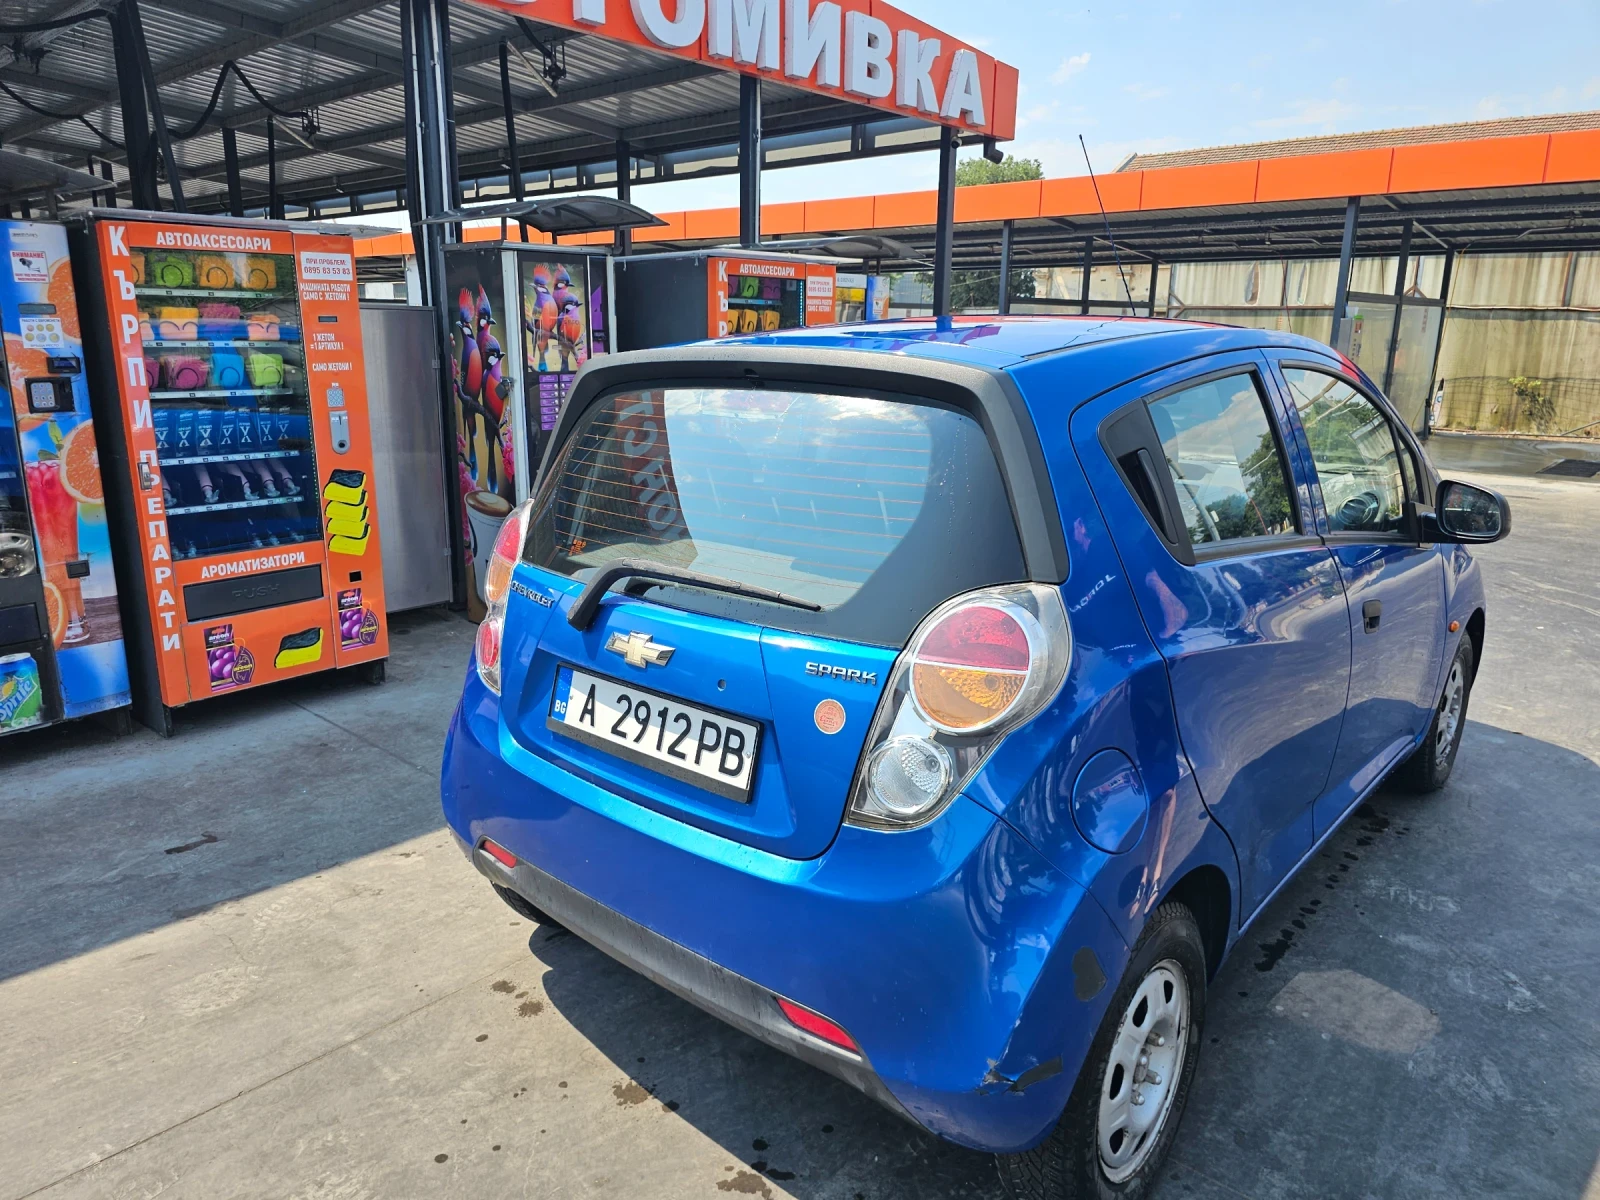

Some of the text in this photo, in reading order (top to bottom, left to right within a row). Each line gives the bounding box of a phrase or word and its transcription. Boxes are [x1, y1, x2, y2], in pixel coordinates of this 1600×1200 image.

[505, 0, 986, 127] ОМИВКА
[156, 231, 271, 251] АВТОАКСЕСОАРИ
[304, 266, 321, 274] 0895
[322, 267, 331, 275] 83
[739, 263, 795, 277] АВТОАКСЕСОАРИ
[303, 292, 319, 300] САМО
[108, 226, 153, 428] КЪРПИ
[312, 362, 327, 371] САМО
[201, 551, 305, 579] АРОМАТИЗАТОРИ
[804, 661, 878, 686] SPARK
[0, 679, 32, 721] Sprite
[554, 699, 567, 714] BG
